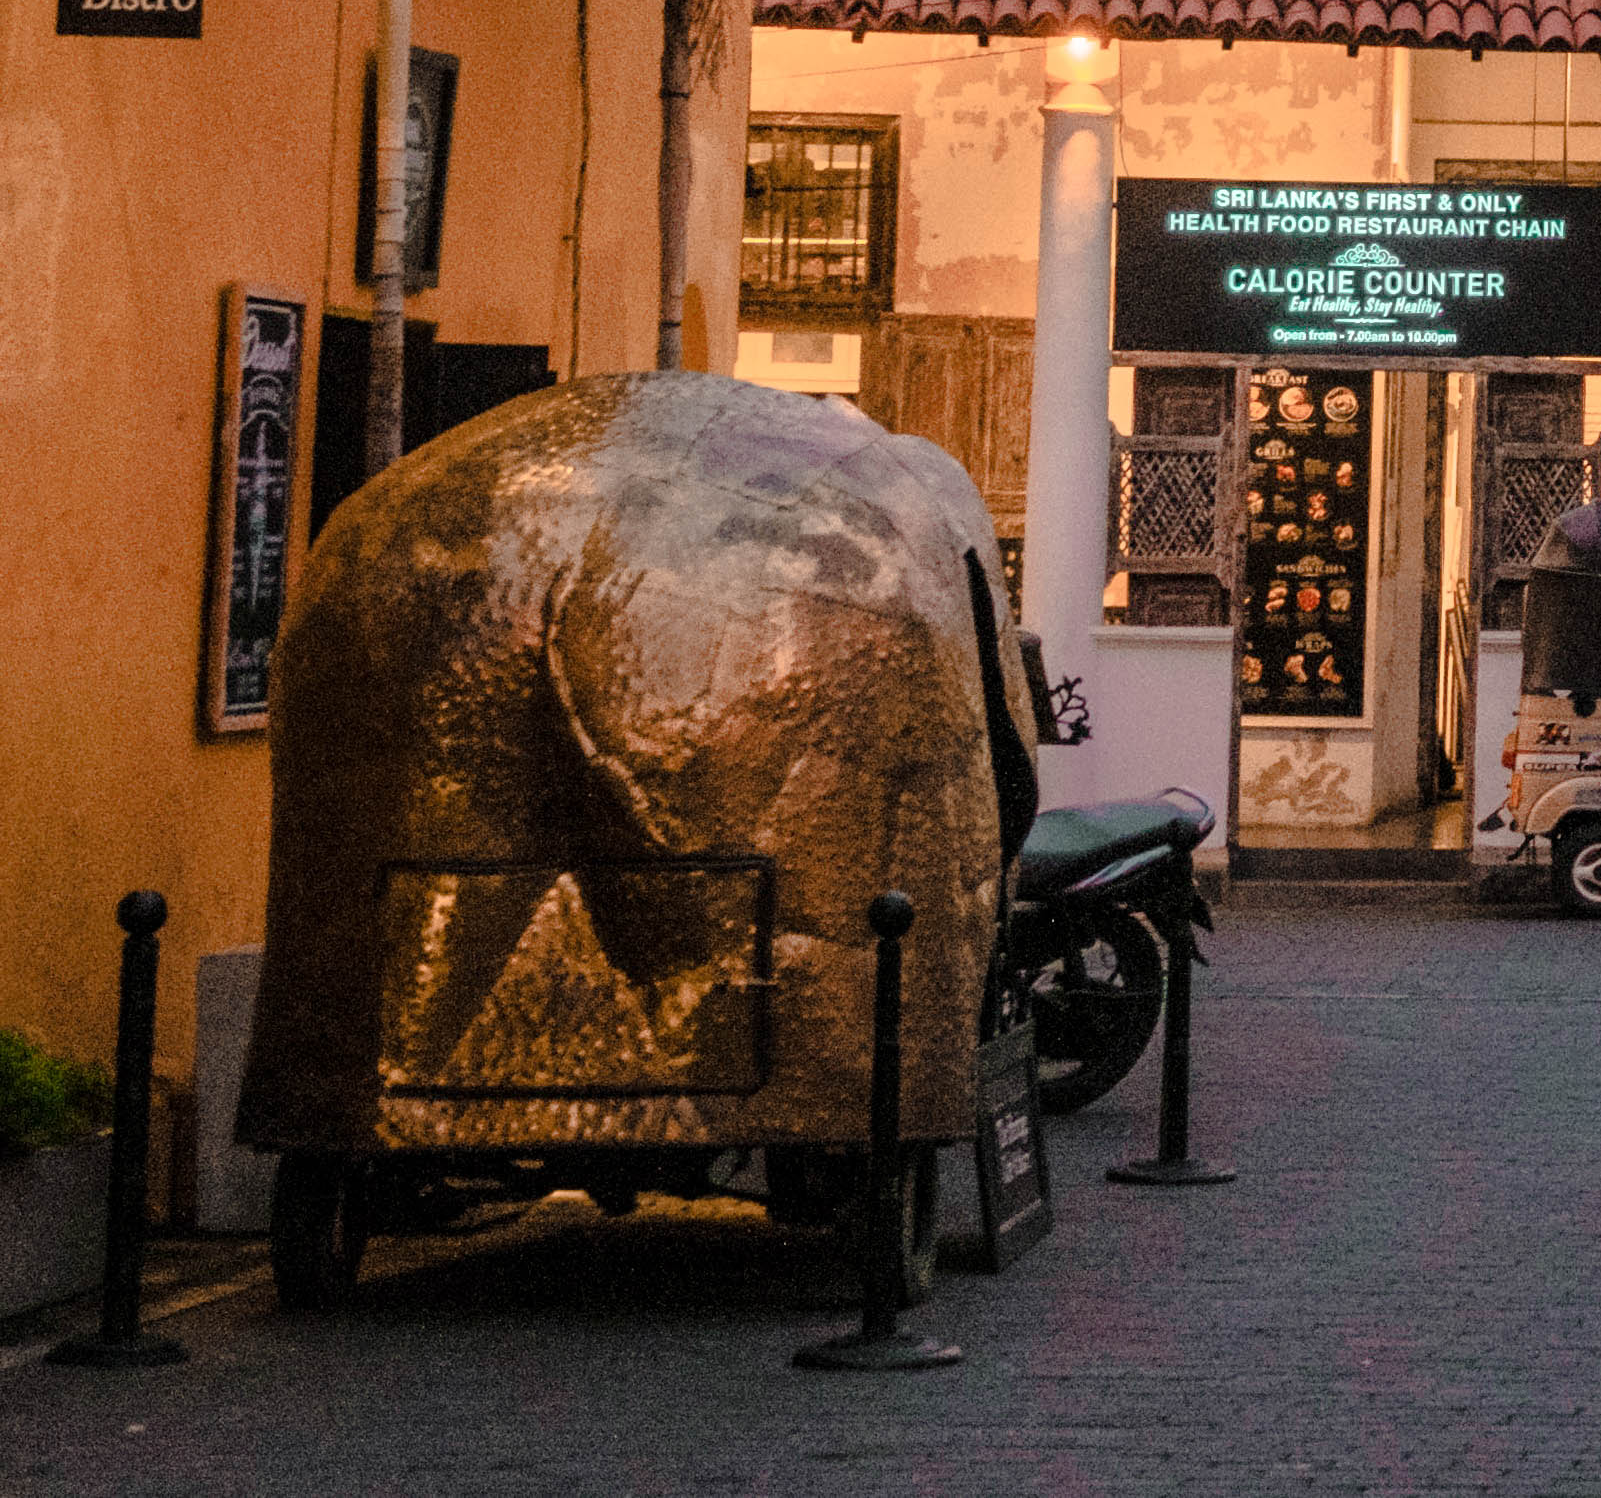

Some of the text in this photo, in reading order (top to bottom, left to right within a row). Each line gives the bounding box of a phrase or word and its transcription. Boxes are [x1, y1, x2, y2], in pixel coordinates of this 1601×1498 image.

[1215, 188, 1522, 213] SRI LANKA'S FIRST & ONLY
[1169, 213, 1566, 239] HEALTH FOOD RESTAURANT CHAIN
[1227, 268, 1505, 297] CALORIE COUNTER
[1288, 296, 1444, 317] Eat Healthy, Stay Healthy.
[1272, 329, 1307, 344] Open
[1308, 329, 1338, 341] from
[1347, 330, 1390, 342] 7.00am
[1391, 331, 1405, 342] to
[1407, 331, 1458, 345] 10.00pm
